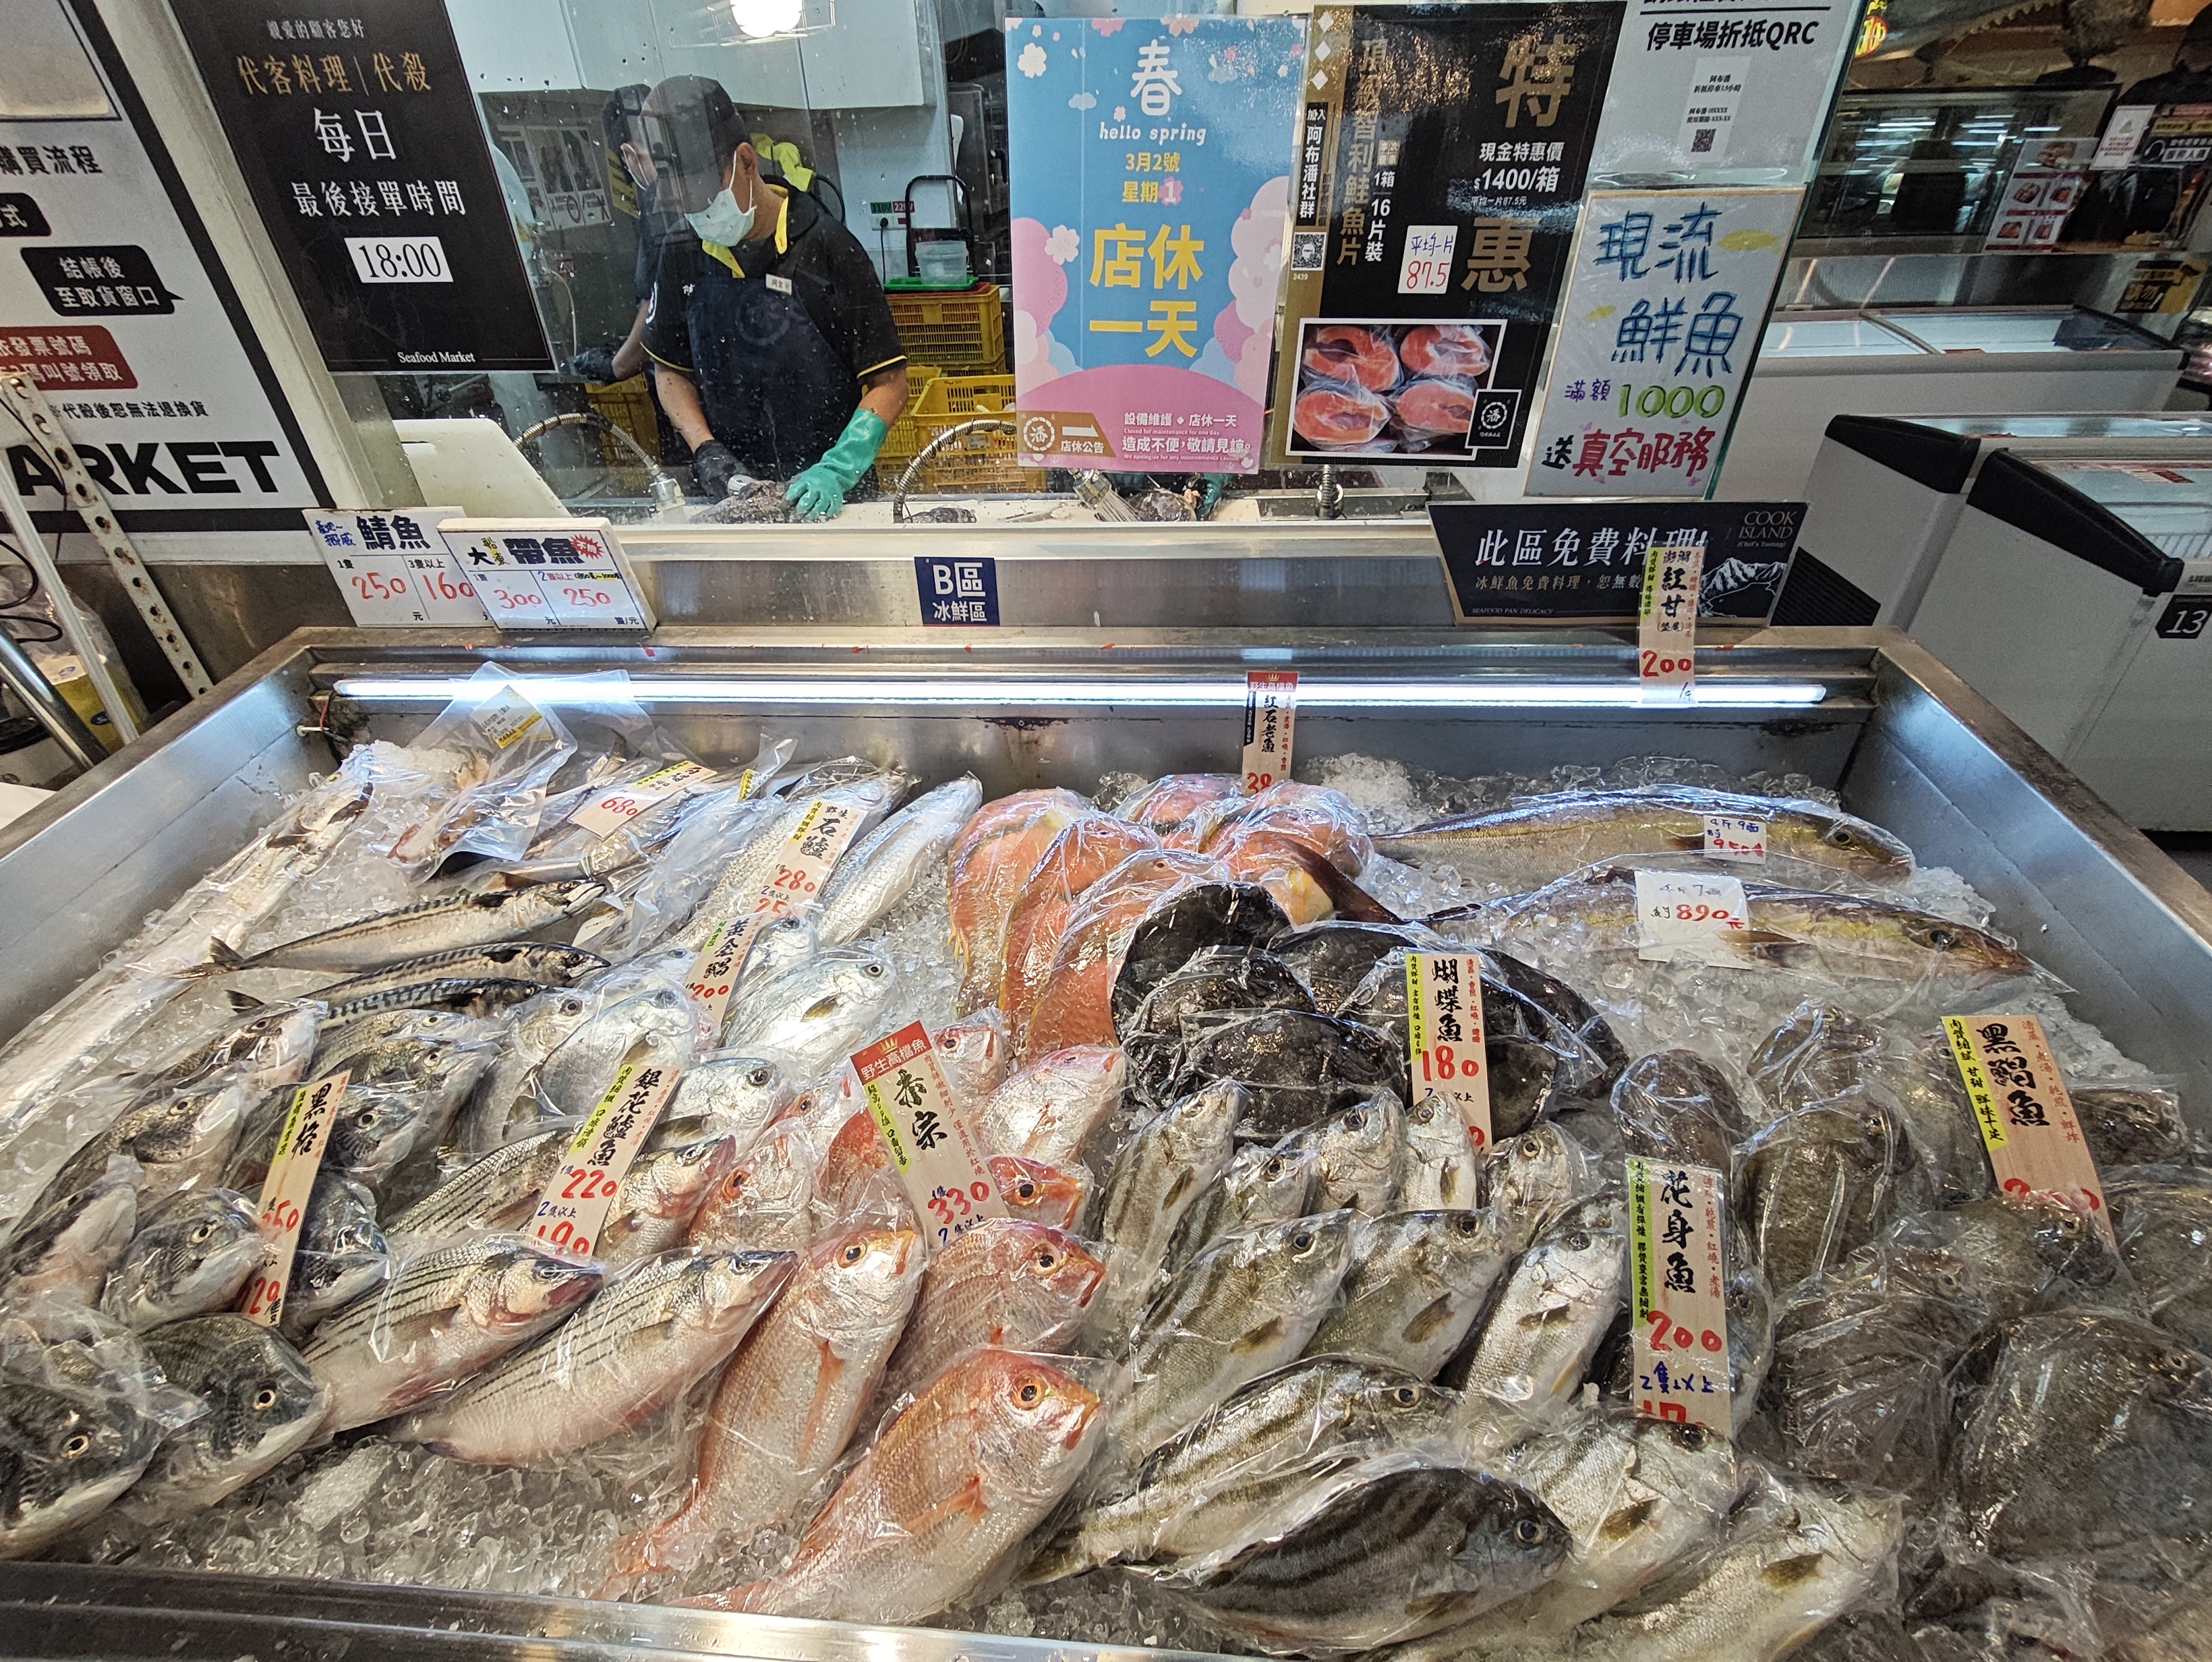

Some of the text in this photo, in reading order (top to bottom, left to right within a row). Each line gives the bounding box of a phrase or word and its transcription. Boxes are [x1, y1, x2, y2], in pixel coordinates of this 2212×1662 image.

[1647, 19, 1820, 51] 停車場折抵QRC
[236, 52, 432, 95] 代客料理 代殺
[1130, 39, 1182, 116] 春
[1307, 109, 1326, 121] 加入
[314, 107, 397, 163] 每日
[1099, 121, 1206, 146] hello spring
[0, 145, 103, 175] 購買流程
[1126, 152, 1181, 173] 3月2號
[1479, 142, 1565, 162] 現金特惠價
[1300, 125, 1323, 219] 阿布潘社群
[1374, 171, 1395, 188] 1箱
[291, 179, 466, 217] 最後接單時間
[0, 204, 28, 228] 式
[1089, 223, 1204, 290] 店休
[1461, 217, 1542, 292] 惠
[1593, 202, 1724, 283] 現流
[59, 256, 125, 279] 結帳後
[358, 243, 441, 279] 18:00
[1407, 260, 1450, 289] 87.5
[53, 285, 160, 308] 至取貨窗口
[1089, 300, 1198, 358] 一天
[1611, 292, 1744, 378] 鮮魚
[397, 351, 475, 363] Seafood Market
[1619, 384, 1725, 418] 1000
[1124, 412, 1238, 427] 設備維護 店休一天
[1061, 440, 1105, 454] 店休公告
[1744, 511, 1797, 525] COOK
[356, 515, 431, 550] 鯖魚
[1739, 526, 1793, 539] ISLAND
[467, 547, 495, 565] 大
[351, 572, 406, 600] 250
[423, 572, 473, 600] 160
[933, 563, 986, 598] B區
[1660, 567, 1688, 618] 紅甘
[493, 590, 542, 609] 300
[563, 588, 611, 607] 250
[932, 600, 987, 622] 冰鮮區
[413, 611, 424, 621] 元
[545, 617, 556, 625] 元
[2165, 610, 2208, 633] 13
[1642, 650, 1692, 677] 200
[601, 797, 638, 815] 680
[774, 869, 816, 892] 280
[861, 1038, 927, 1080] 野生高檔魚
[1422, 1045, 1479, 1082] 180
[561, 1168, 617, 1199] 220
[928, 1181, 991, 1224] 330
[1660, 1169, 1696, 1294] 花身魚
[1646, 1310, 1723, 1352] 200
